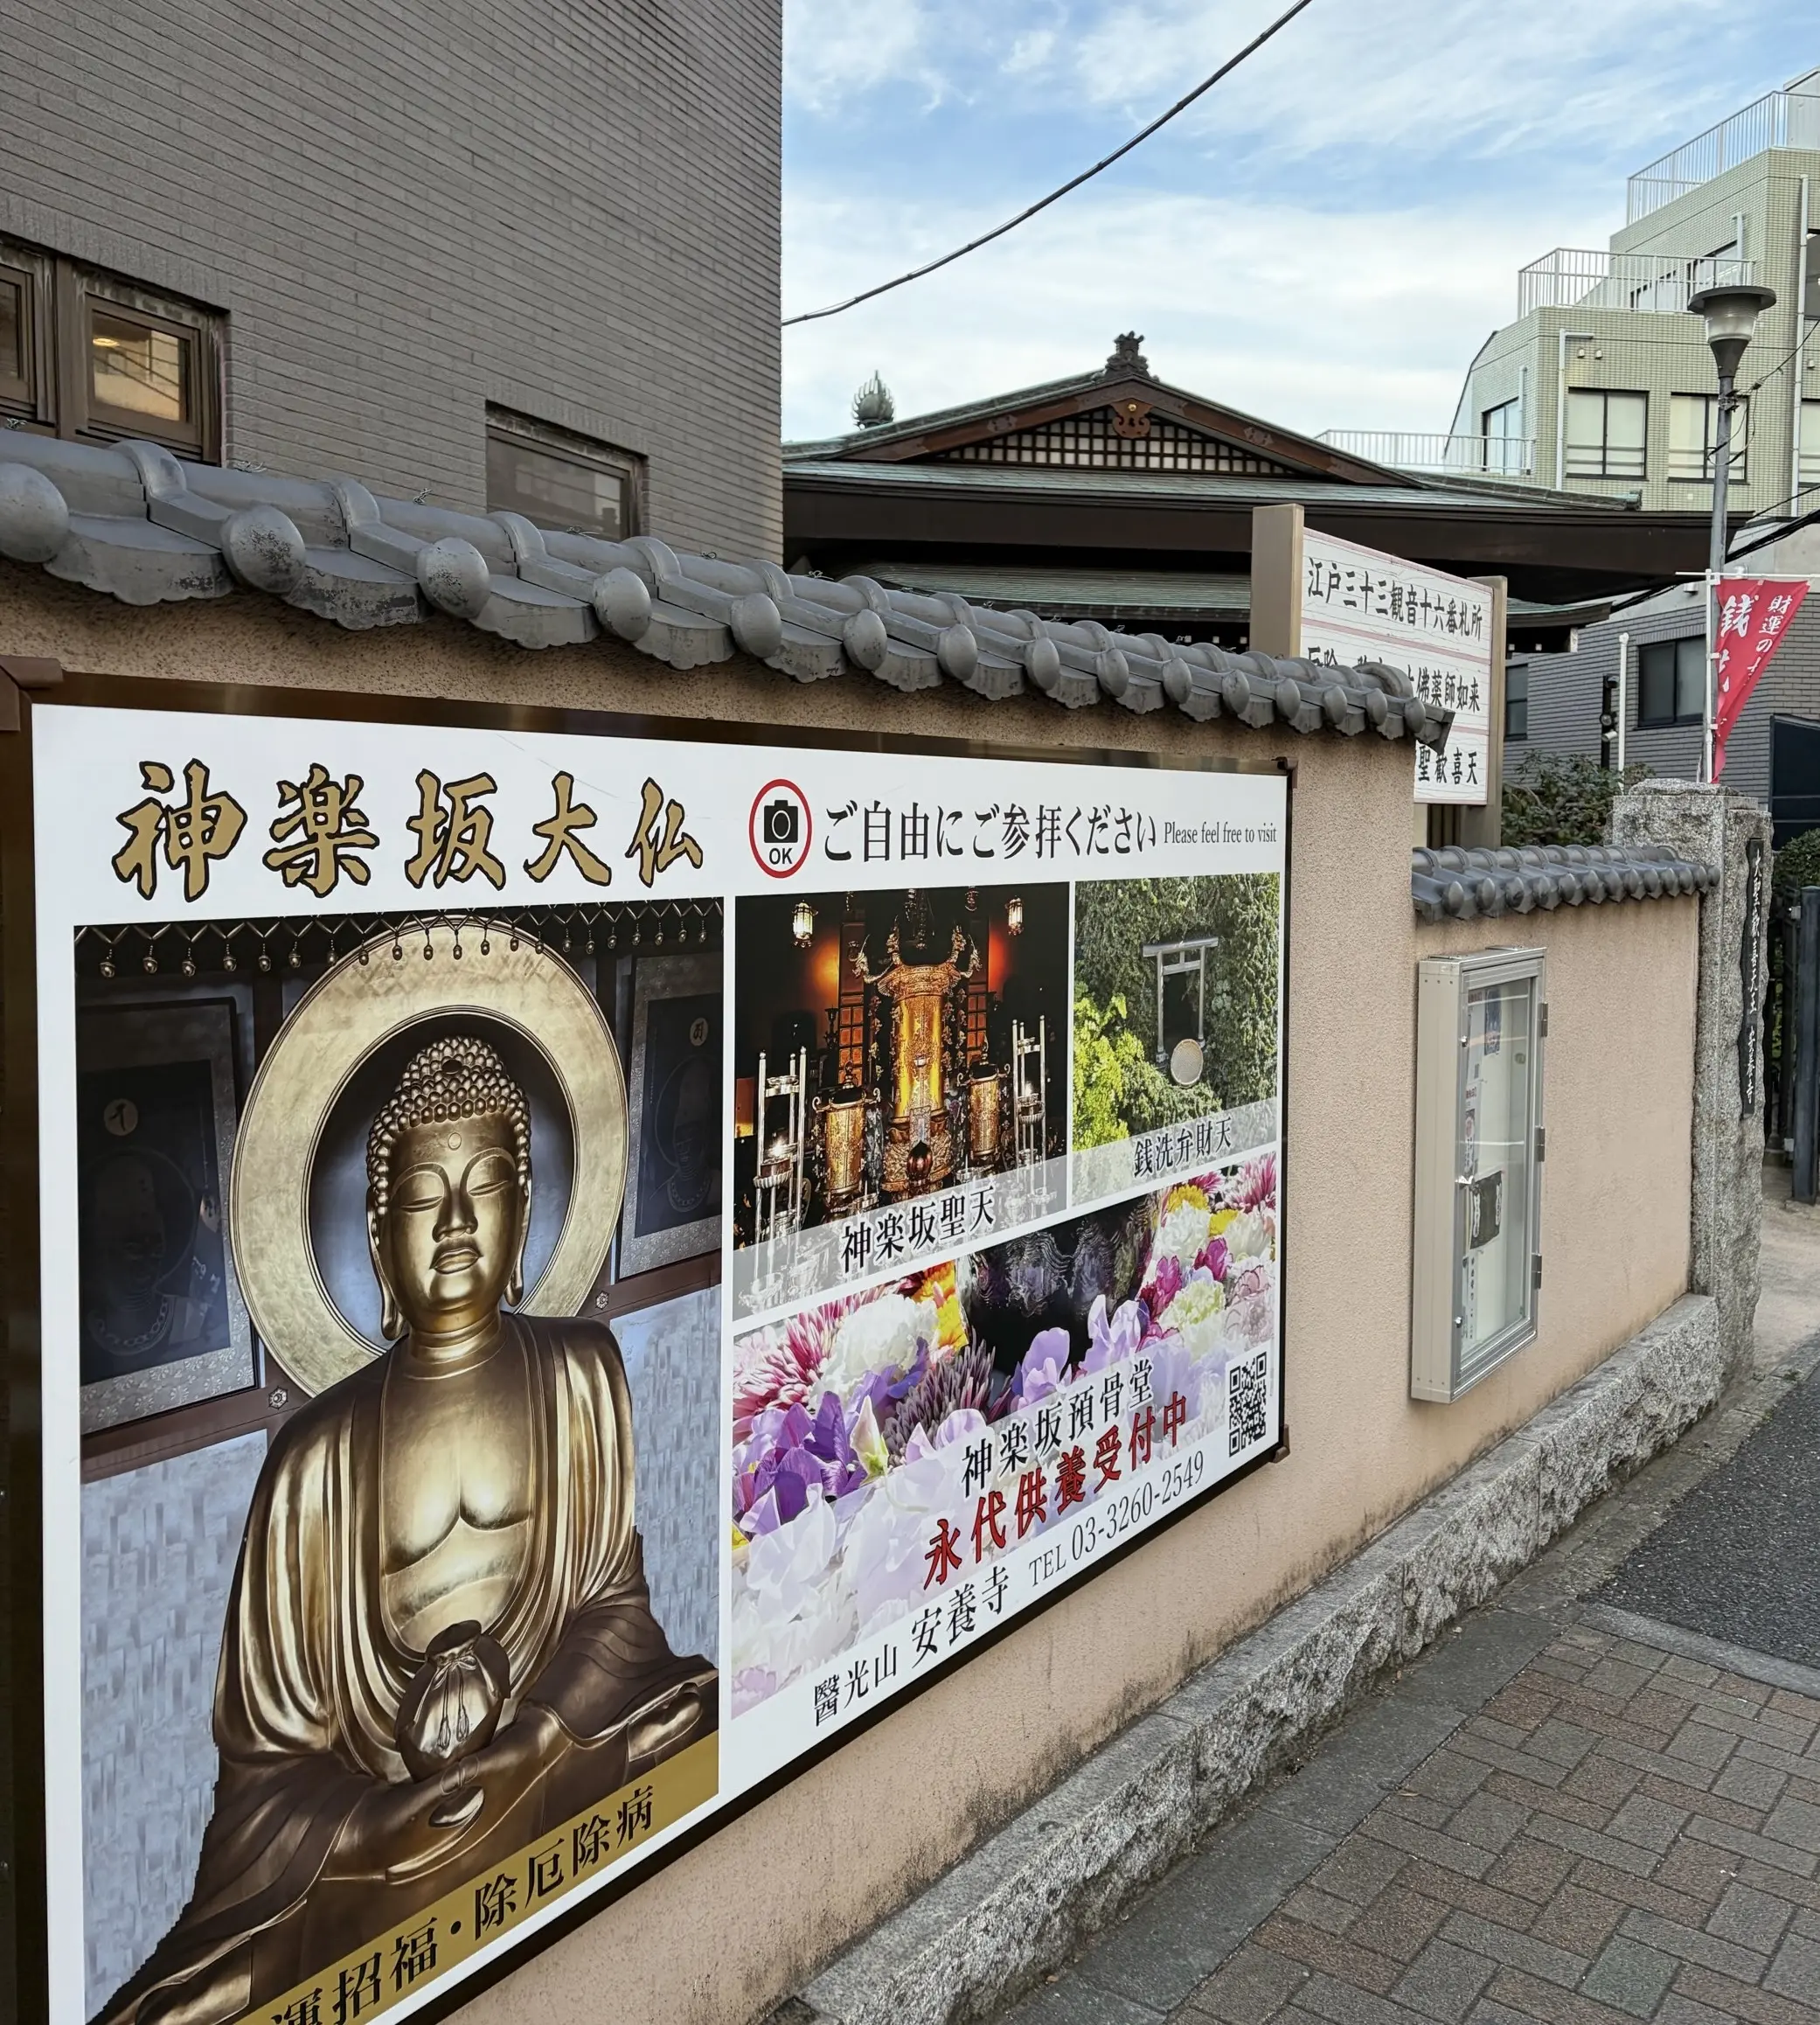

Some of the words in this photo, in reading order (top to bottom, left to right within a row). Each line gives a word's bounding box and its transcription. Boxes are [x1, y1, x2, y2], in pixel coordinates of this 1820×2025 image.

[1308, 557, 1483, 642] 江戸三十三観音十六番札所
[112, 758, 704, 901] 神楽坂大仏
[769, 847, 793, 865] OK
[823, 799, 1157, 861] ご自由にご参拝ください
[1164, 821, 1198, 843] Please
[1201, 821, 1219, 843] feel
[1222, 821, 1242, 843] free
[1245, 827, 1255, 843] to
[1257, 822, 1277, 843] visit
[1134, 1117, 1232, 1179] 銭洗弁財天
[840, 1186, 995, 1273] 神楽坂聖天
[962, 1358, 1153, 1498] 神楽坂預骨堂
[923, 1390, 1188, 1590] 永代供養受付中
[912, 1566, 1009, 1668] 安養寺
[1028, 1545, 1066, 1587] TEL
[1072, 1451, 1205, 1562] 03-3260-2549
